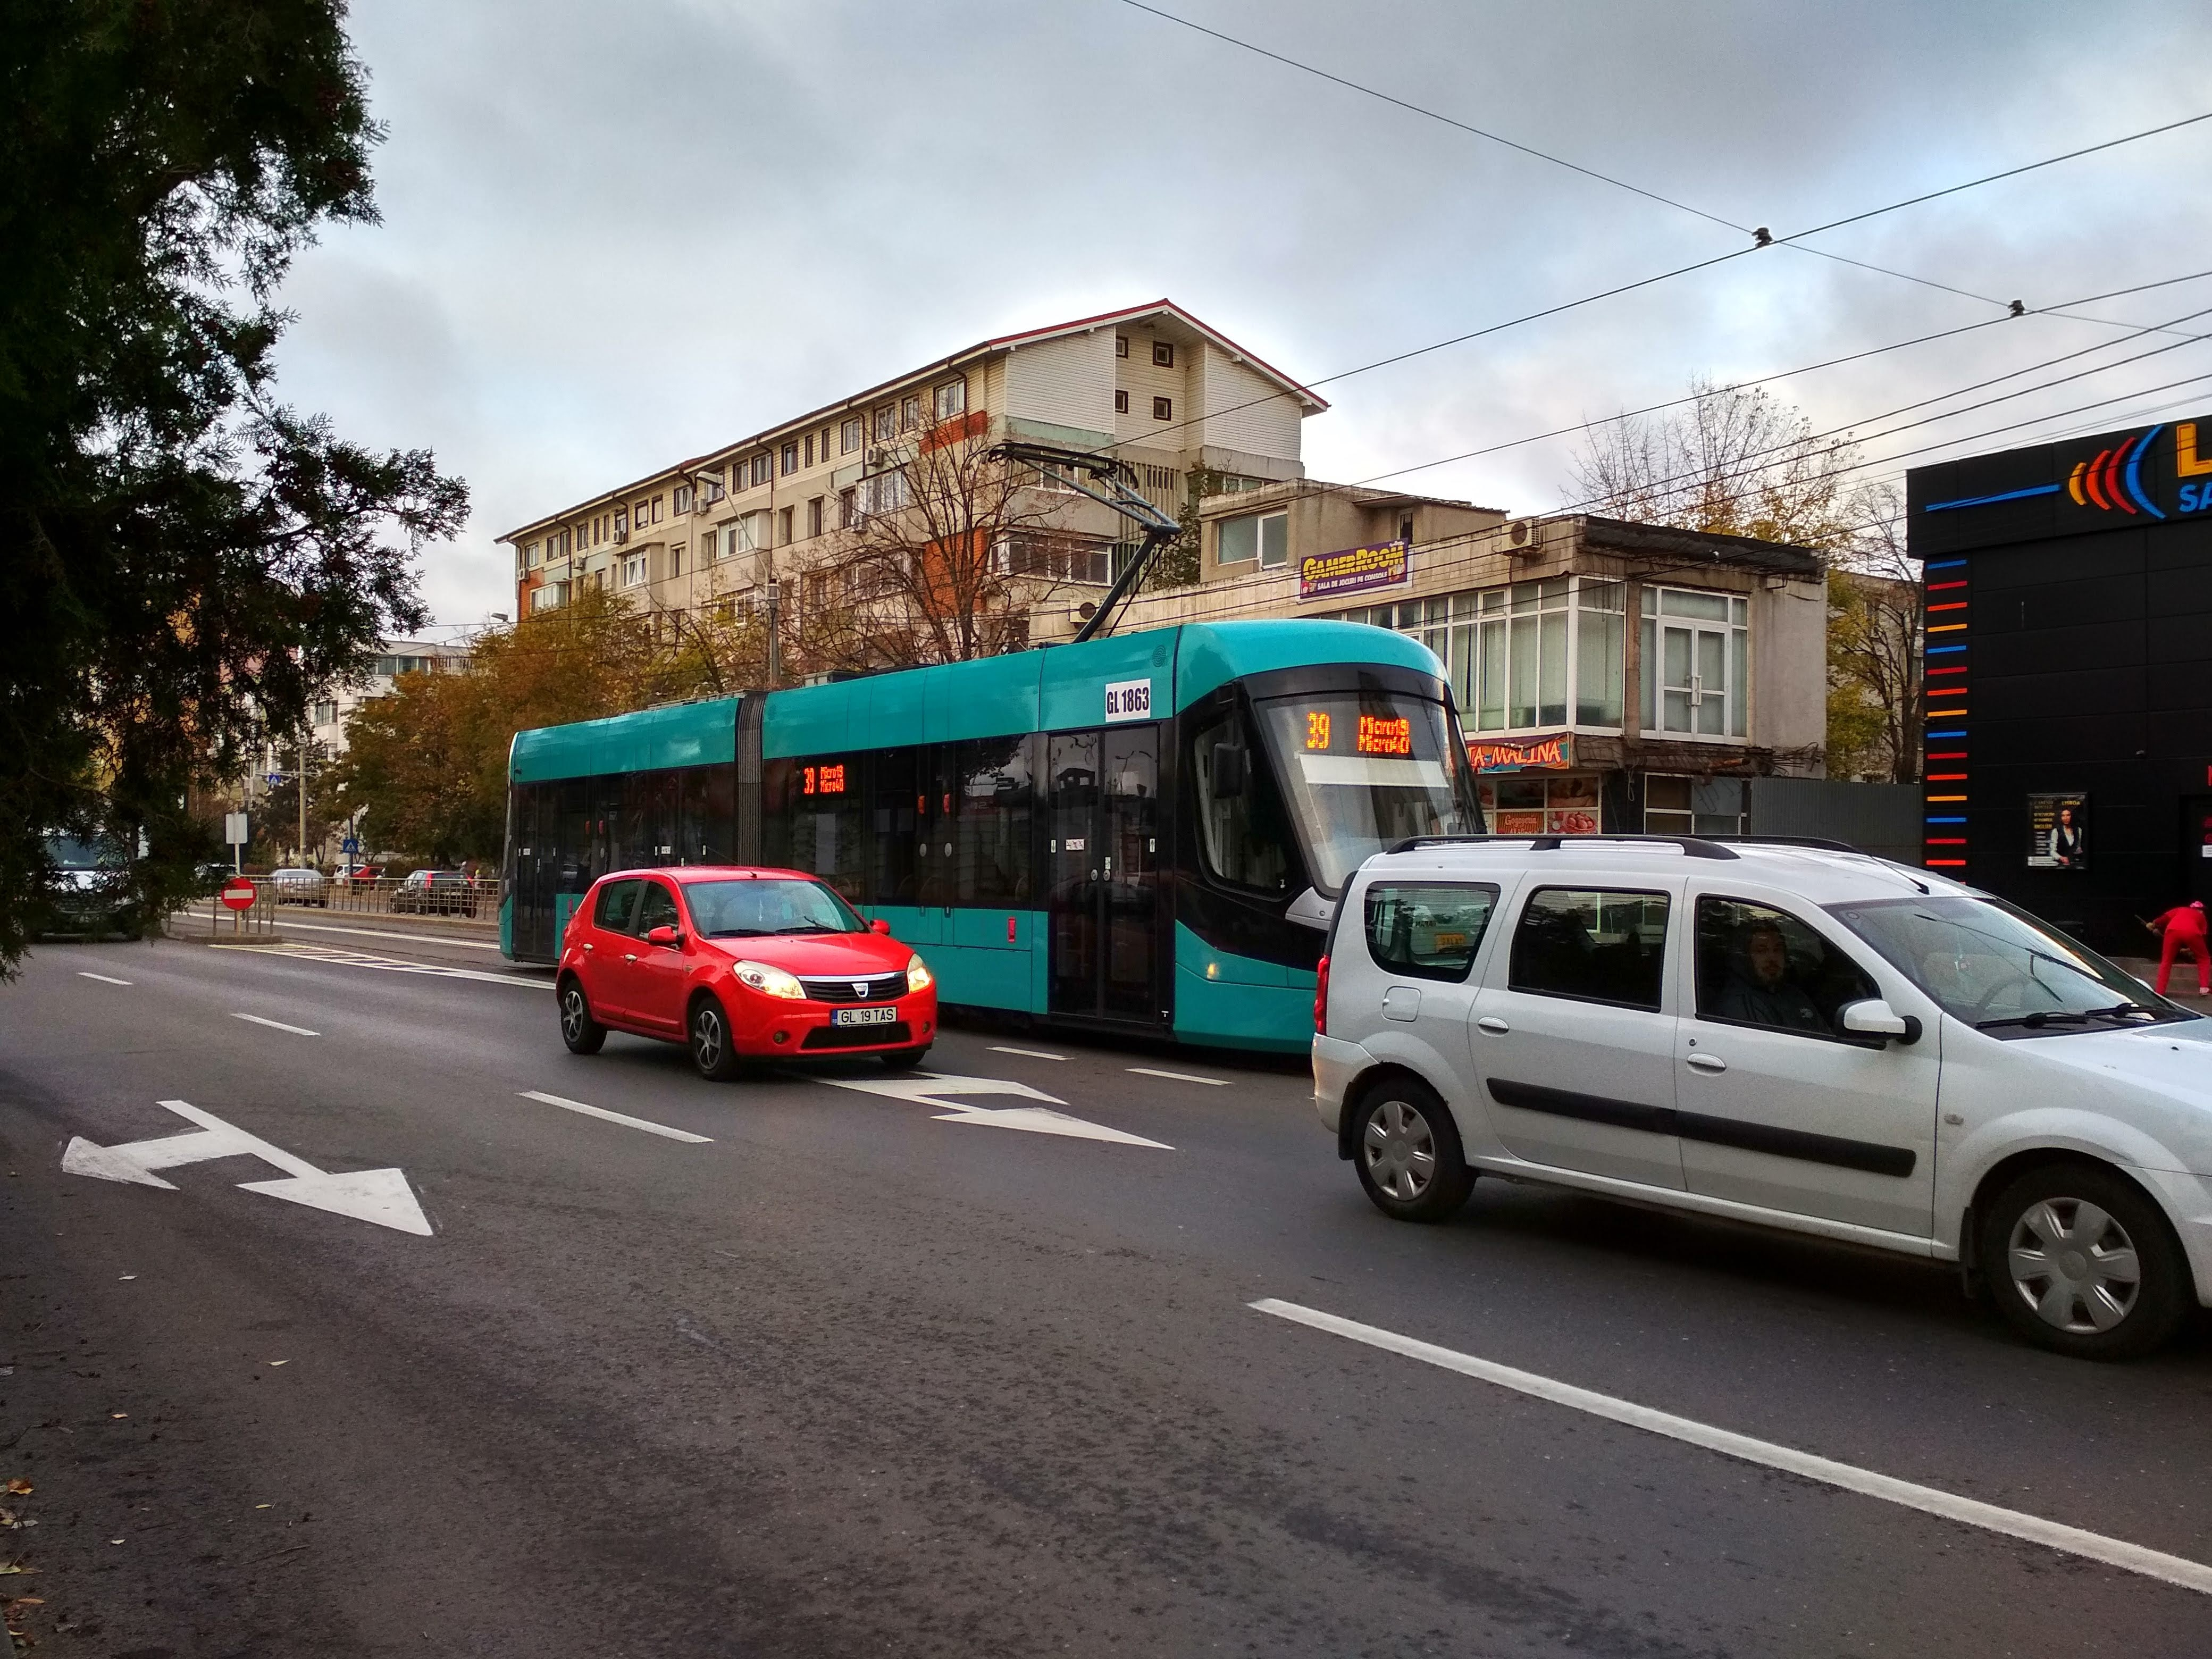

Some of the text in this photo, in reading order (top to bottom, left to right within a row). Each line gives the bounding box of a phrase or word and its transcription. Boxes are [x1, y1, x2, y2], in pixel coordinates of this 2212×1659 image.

[2176, 423, 2212, 477] L
[1317, 582, 1330, 590] SALA
[1338, 577, 1356, 586] JOCURI
[1364, 571, 1388, 581] CONSOLE
[1107, 686, 1149, 715] GL 1863
[1306, 711, 1330, 749] 39
[1492, 741, 1561, 765] MALINA
[841, 1009, 894, 1023] GL 19 TAS
